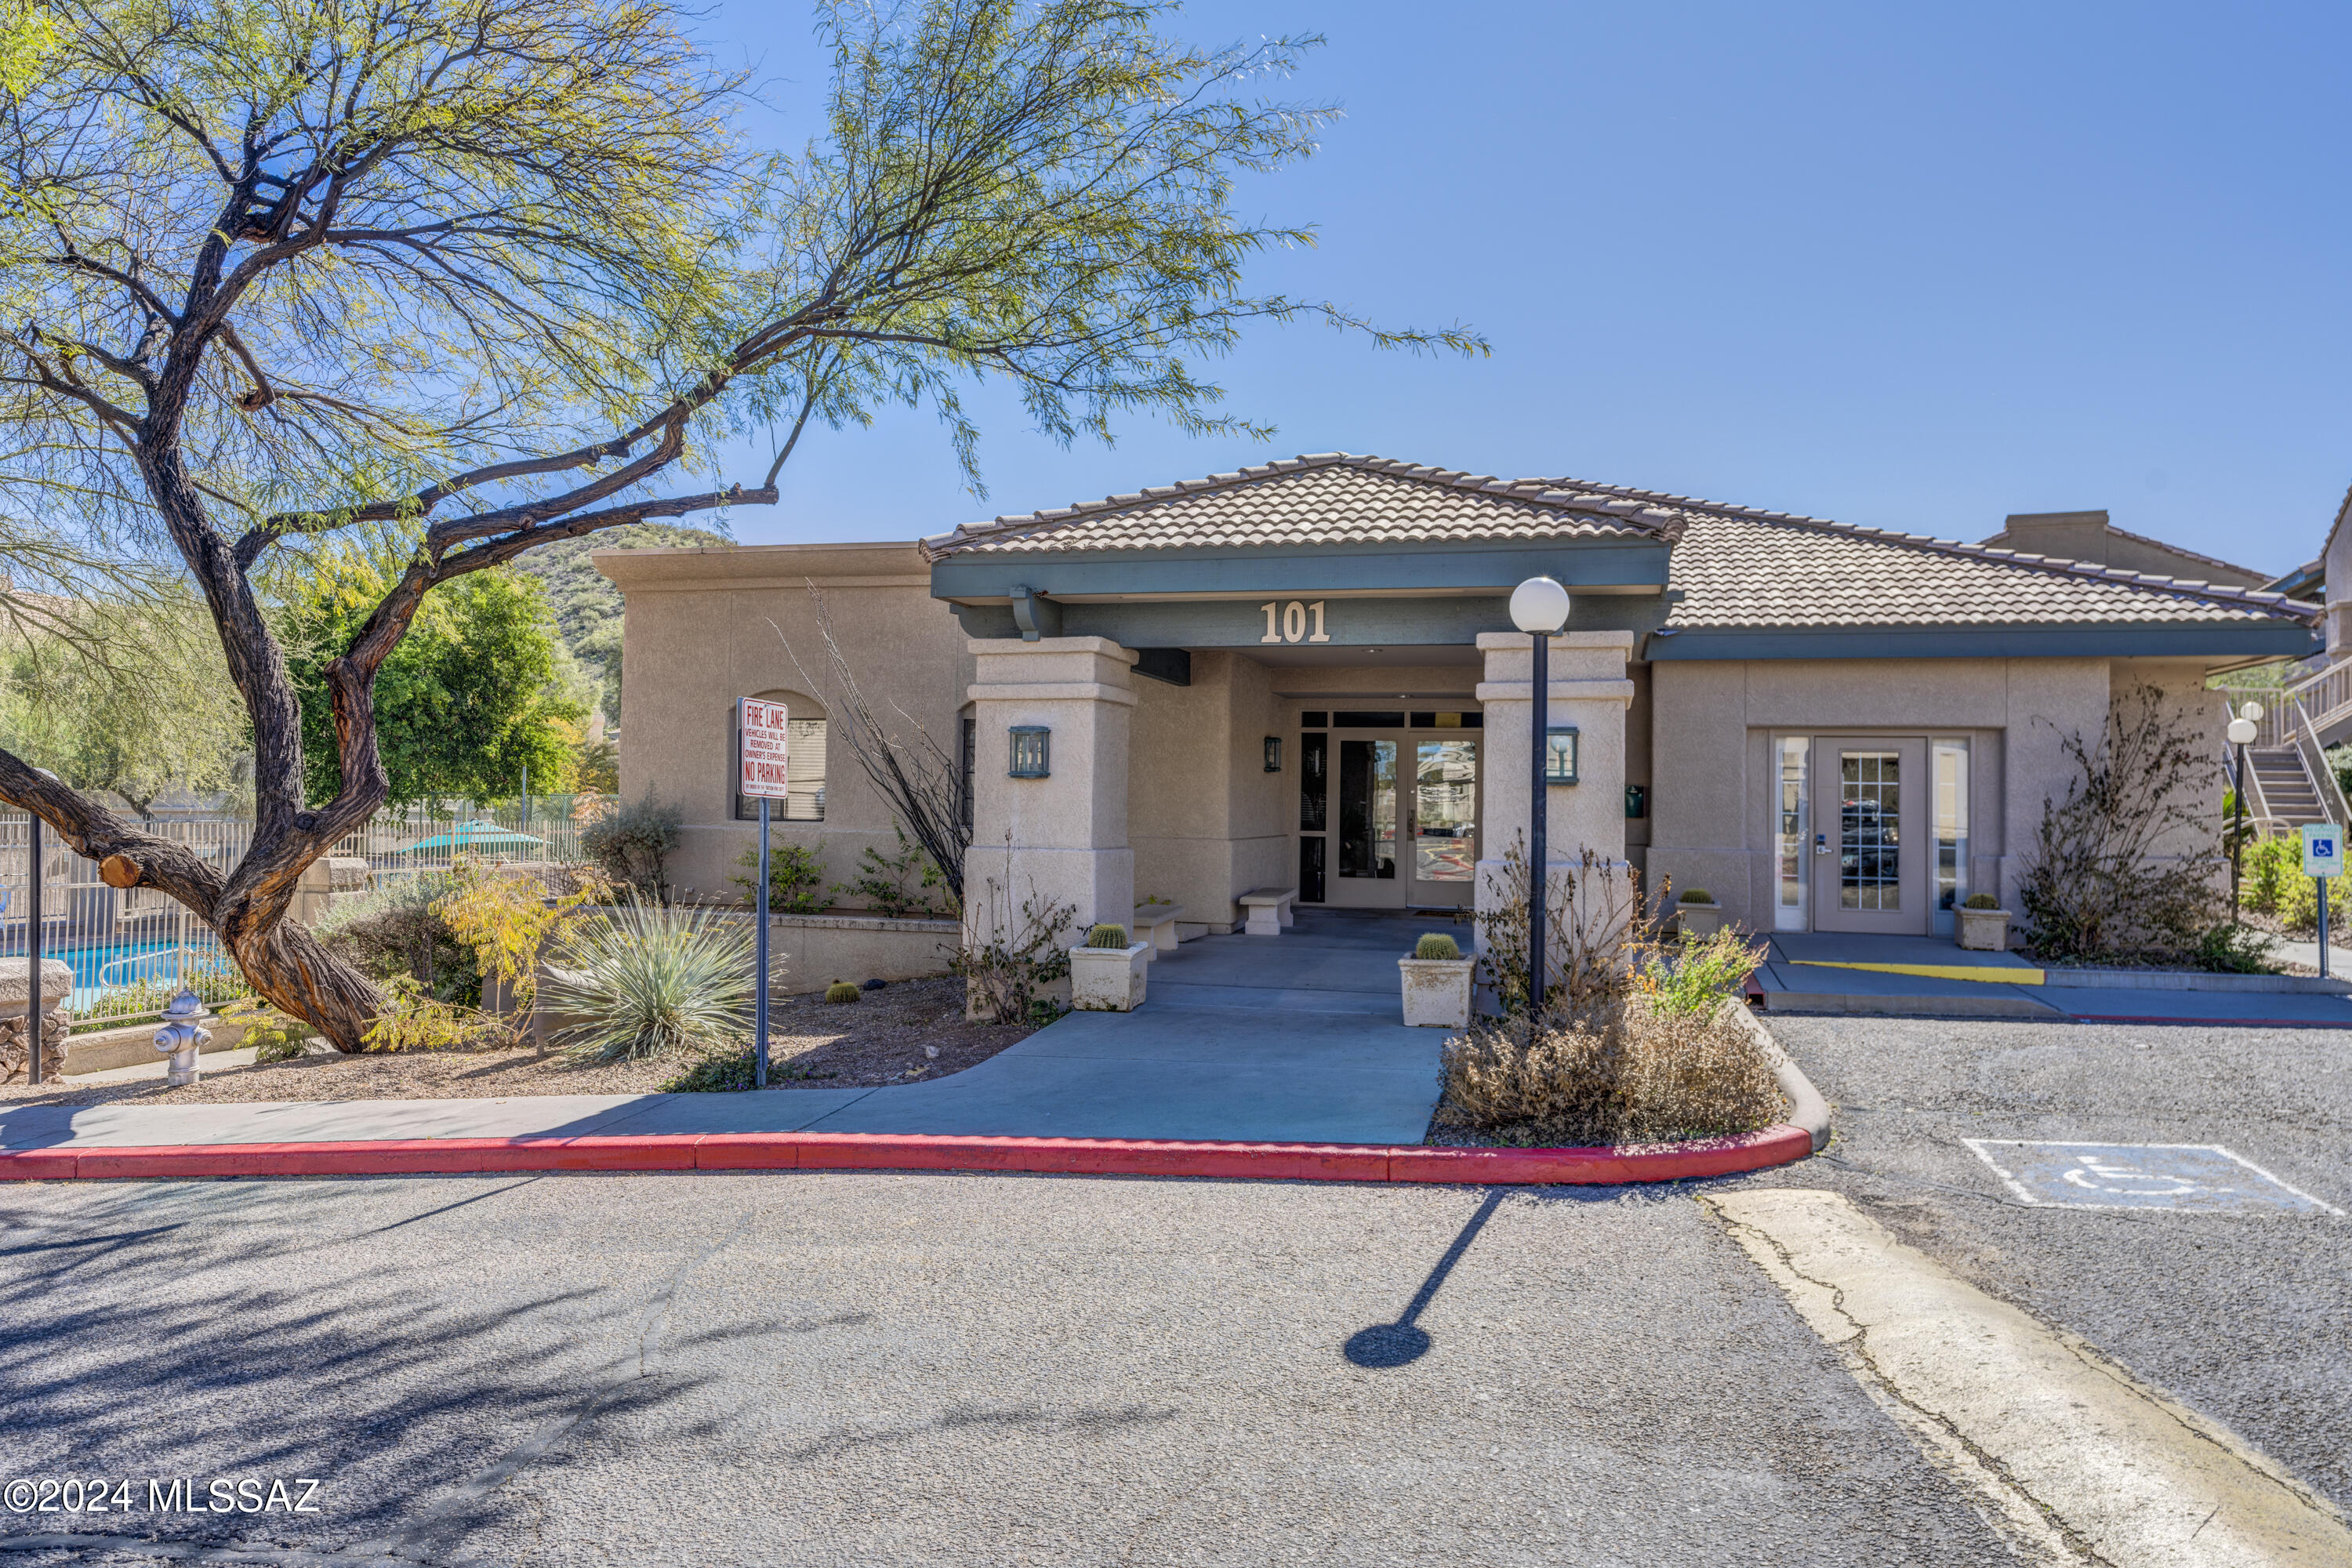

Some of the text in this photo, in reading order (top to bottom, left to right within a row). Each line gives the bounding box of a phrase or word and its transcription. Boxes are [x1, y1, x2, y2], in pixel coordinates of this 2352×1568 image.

[1261, 601, 1330, 643] 101
[747, 705, 783, 730] FIRE LANE
[745, 728, 786, 742] VEHICLES WILL BE
[750, 739, 781, 751] REMOVED AT
[746, 750, 785, 762] OWNER'S EXPENSE
[746, 760, 785, 784] NO PARKING
